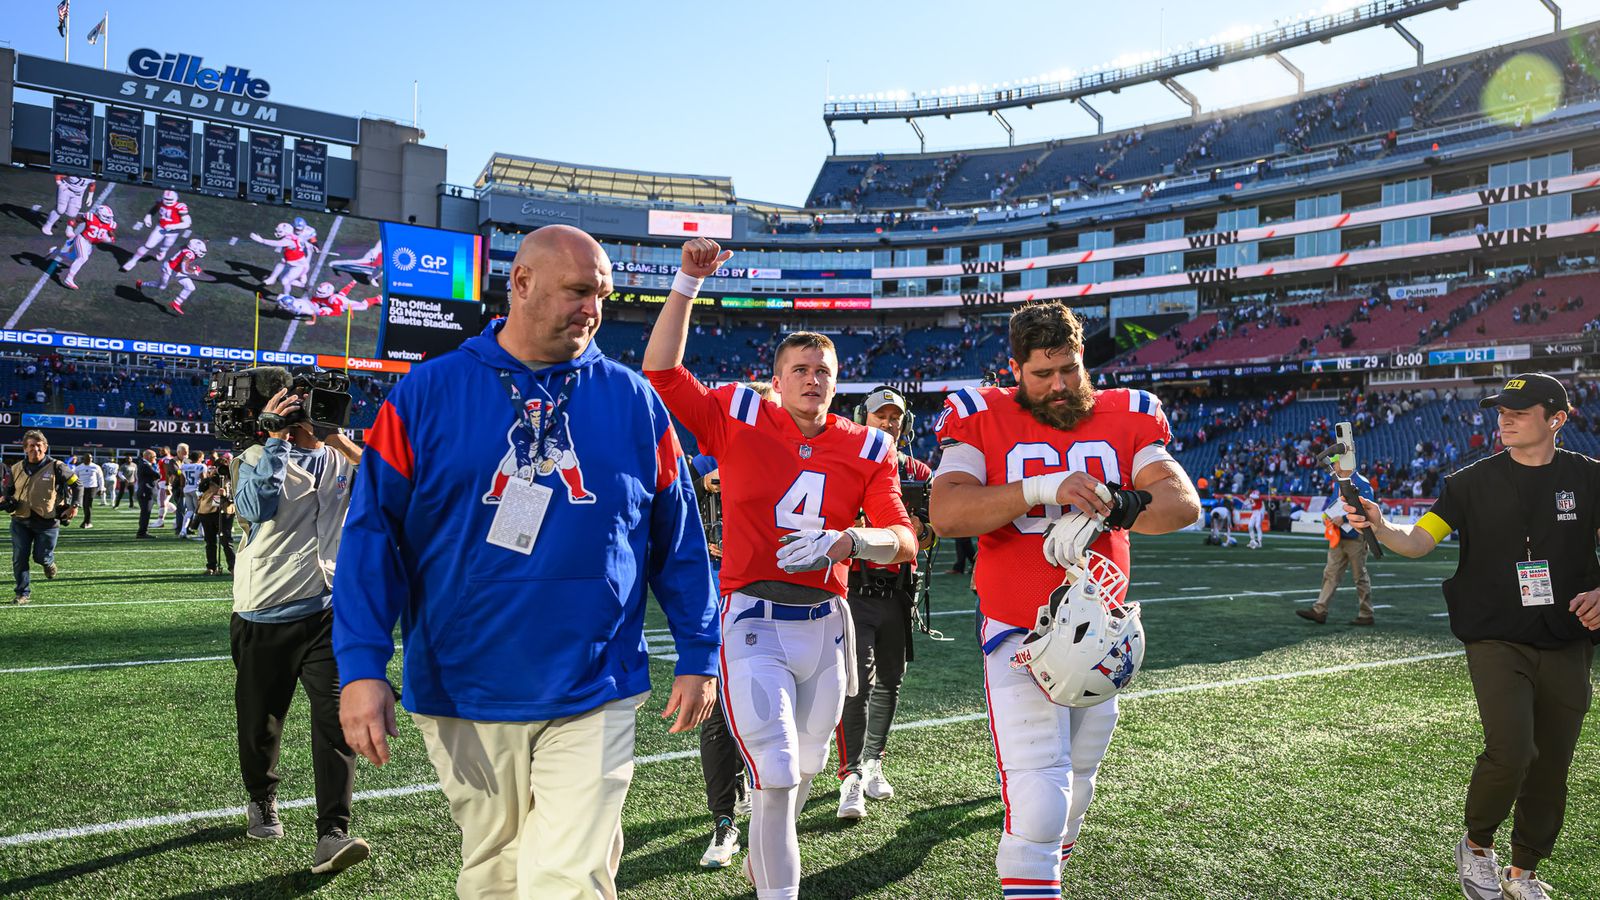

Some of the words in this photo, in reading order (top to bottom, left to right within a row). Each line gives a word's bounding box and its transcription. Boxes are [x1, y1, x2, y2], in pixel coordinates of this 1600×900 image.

[128, 47, 271, 100] Gillette
[120, 81, 278, 122] STADIUM
[56, 155, 87, 166] 2001
[107, 163, 139, 174] 2003
[157, 170, 188, 181] 2004
[207, 179, 234, 189] 2014
[253, 185, 278, 195] 2016
[297, 192, 322, 201] 2018
[1478, 179, 1549, 205] WIN!
[1188, 231, 1239, 248] WIN!
[1476, 224, 1548, 248] WIN!
[626, 263, 657, 274] GAME
[659, 265, 669, 274] IS
[732, 268, 745, 278] BY
[962, 261, 1005, 275] WIN!
[1188, 267, 1238, 285] WIN!
[1405, 286, 1438, 296] Putnam
[389, 298, 407, 308] The
[409, 300, 441, 312] Official
[961, 292, 1005, 306] WIN!
[389, 306, 403, 316] 5G
[405, 308, 443, 320] Network
[444, 313, 454, 321] of
[389, 315, 422, 326] Gillette
[423, 319, 463, 330] Stadium.
[0, 331, 53, 345] EICO
[62, 336, 124, 350] GEICO
[133, 342, 191, 355] GEICO
[199, 347, 255, 360] GEICO
[263, 352, 315, 365] GEICO
[388, 350, 422, 361] verizon
[1337, 358, 1352, 370] NE
[1396, 353, 1423, 366] 0:00
[1465, 349, 1488, 362] DET
[347, 358, 382, 369] Optum
[64, 416, 90, 428] DET
[150, 420, 177, 433] 2ND
[181, 422, 191, 433] &
[195, 423, 210, 434] 11
[775, 470, 826, 531] 4
[1558, 500, 1574, 509] NFL
[1557, 513, 1577, 521] MEDIA
